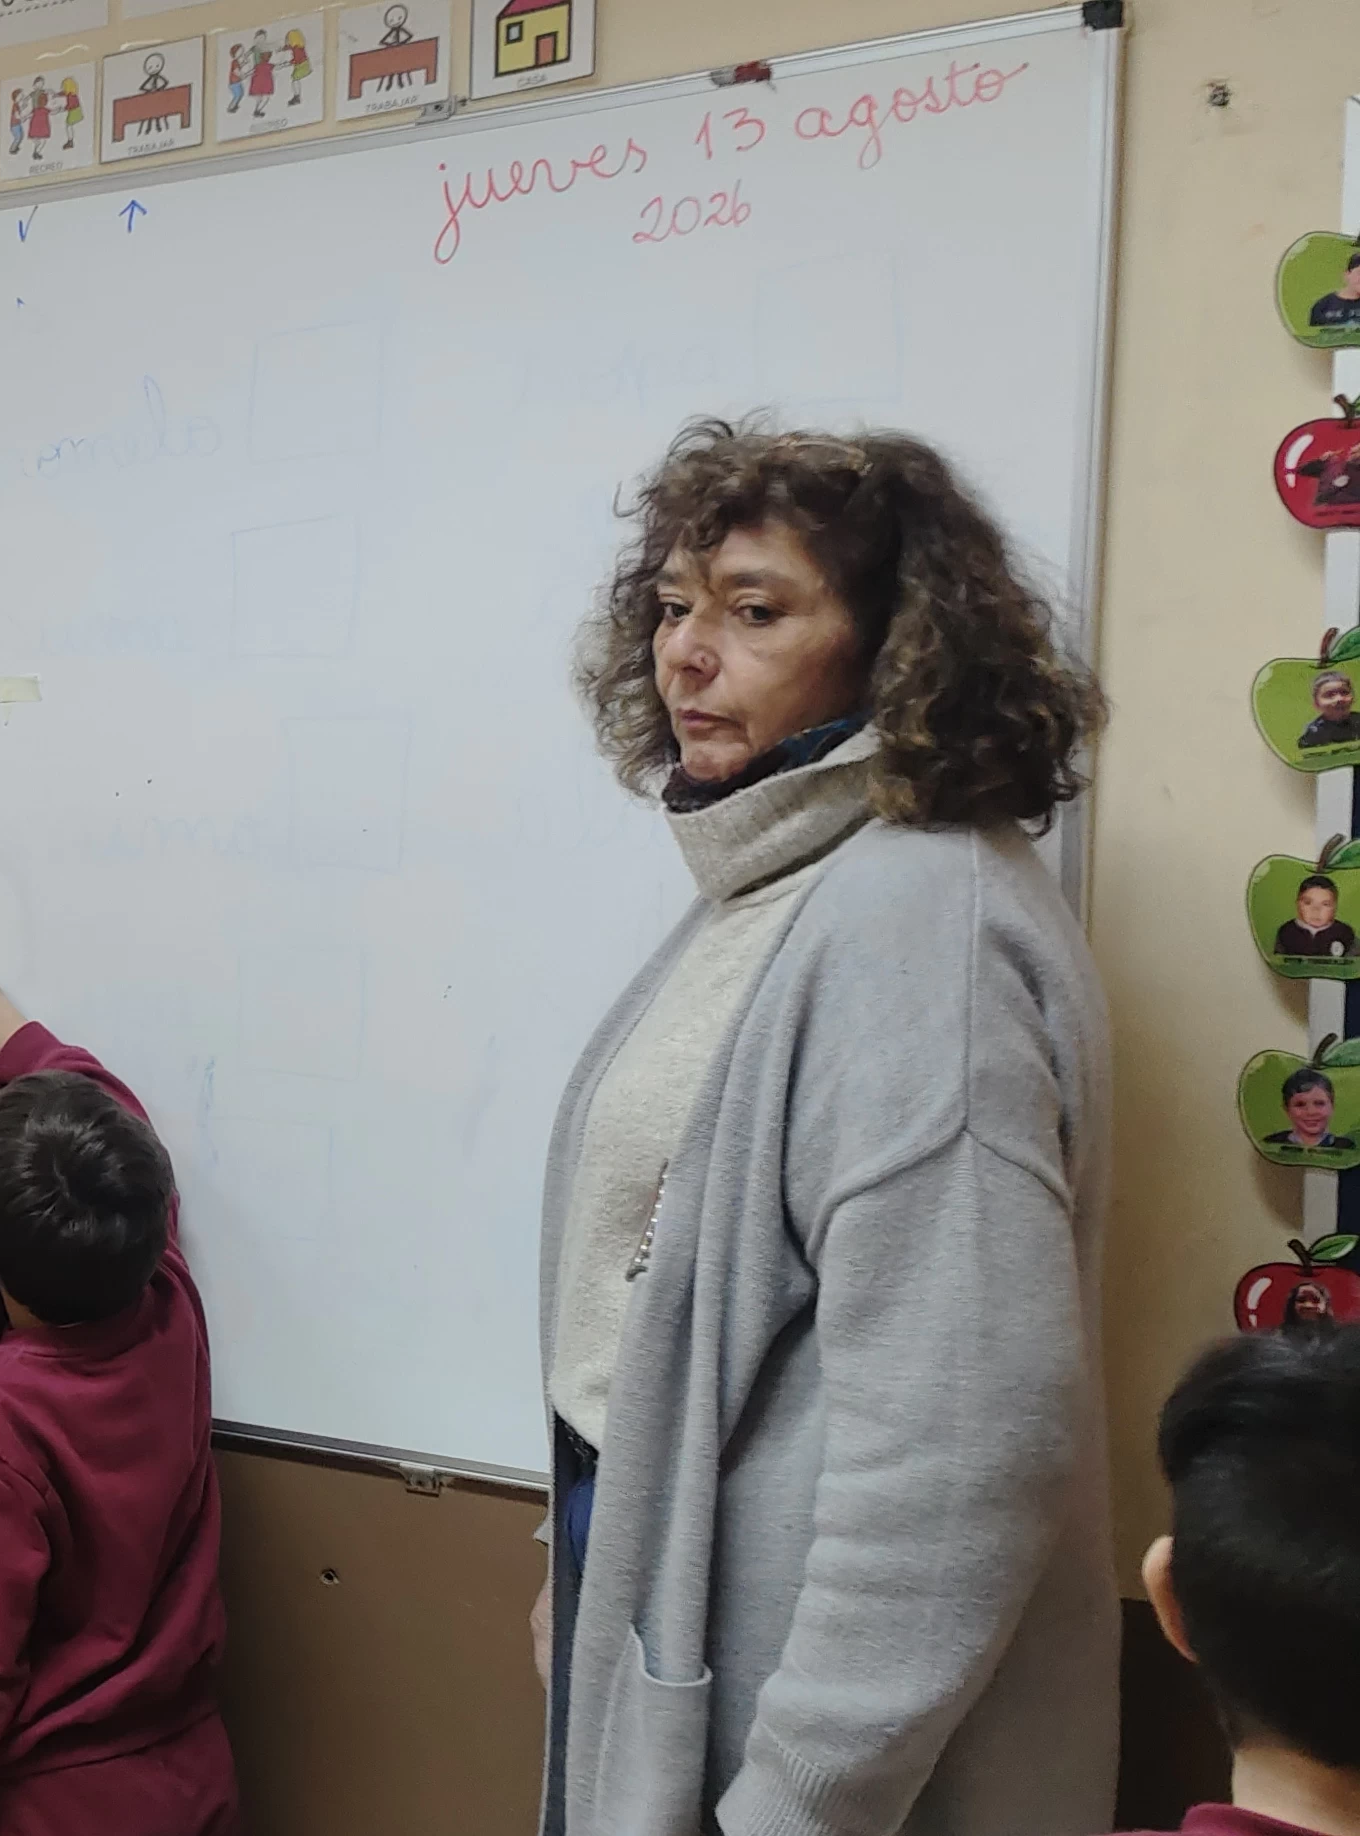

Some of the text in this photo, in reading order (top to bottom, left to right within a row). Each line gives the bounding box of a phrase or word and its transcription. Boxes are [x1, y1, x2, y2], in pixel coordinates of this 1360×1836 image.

[433, 61, 1030, 265] jueves 13 agosto
[632, 178, 752, 244] 2026
